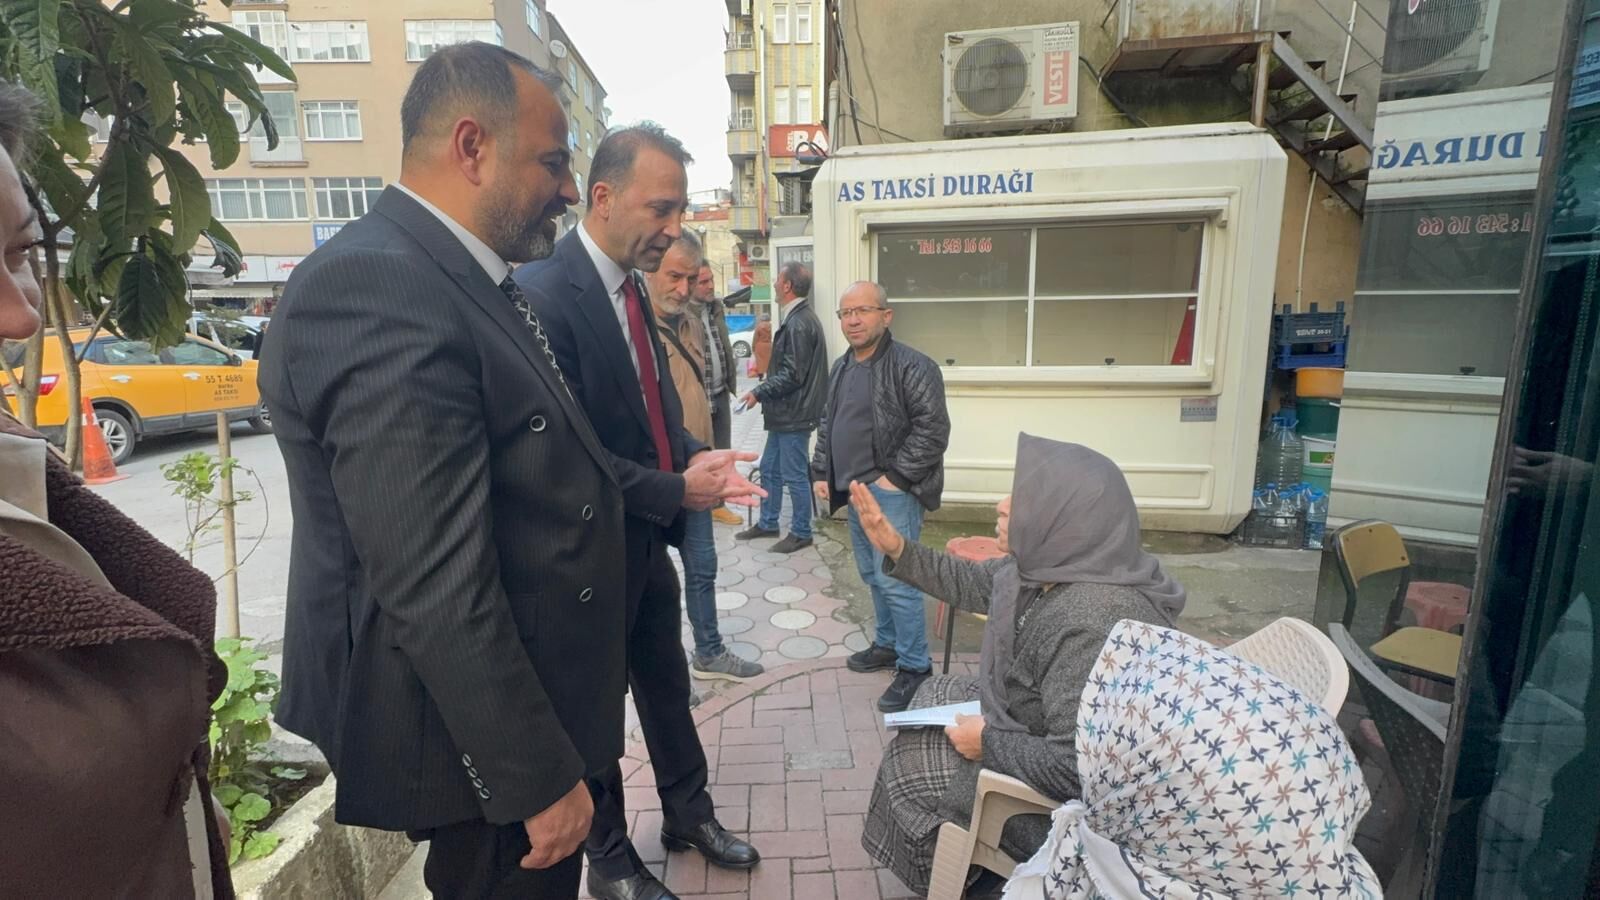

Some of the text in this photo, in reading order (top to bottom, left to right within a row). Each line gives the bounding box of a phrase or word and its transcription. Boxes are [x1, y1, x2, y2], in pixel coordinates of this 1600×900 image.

[837, 169, 1034, 202] AS TAKSİ DURAĞI
[978, 236, 992, 253] 66
